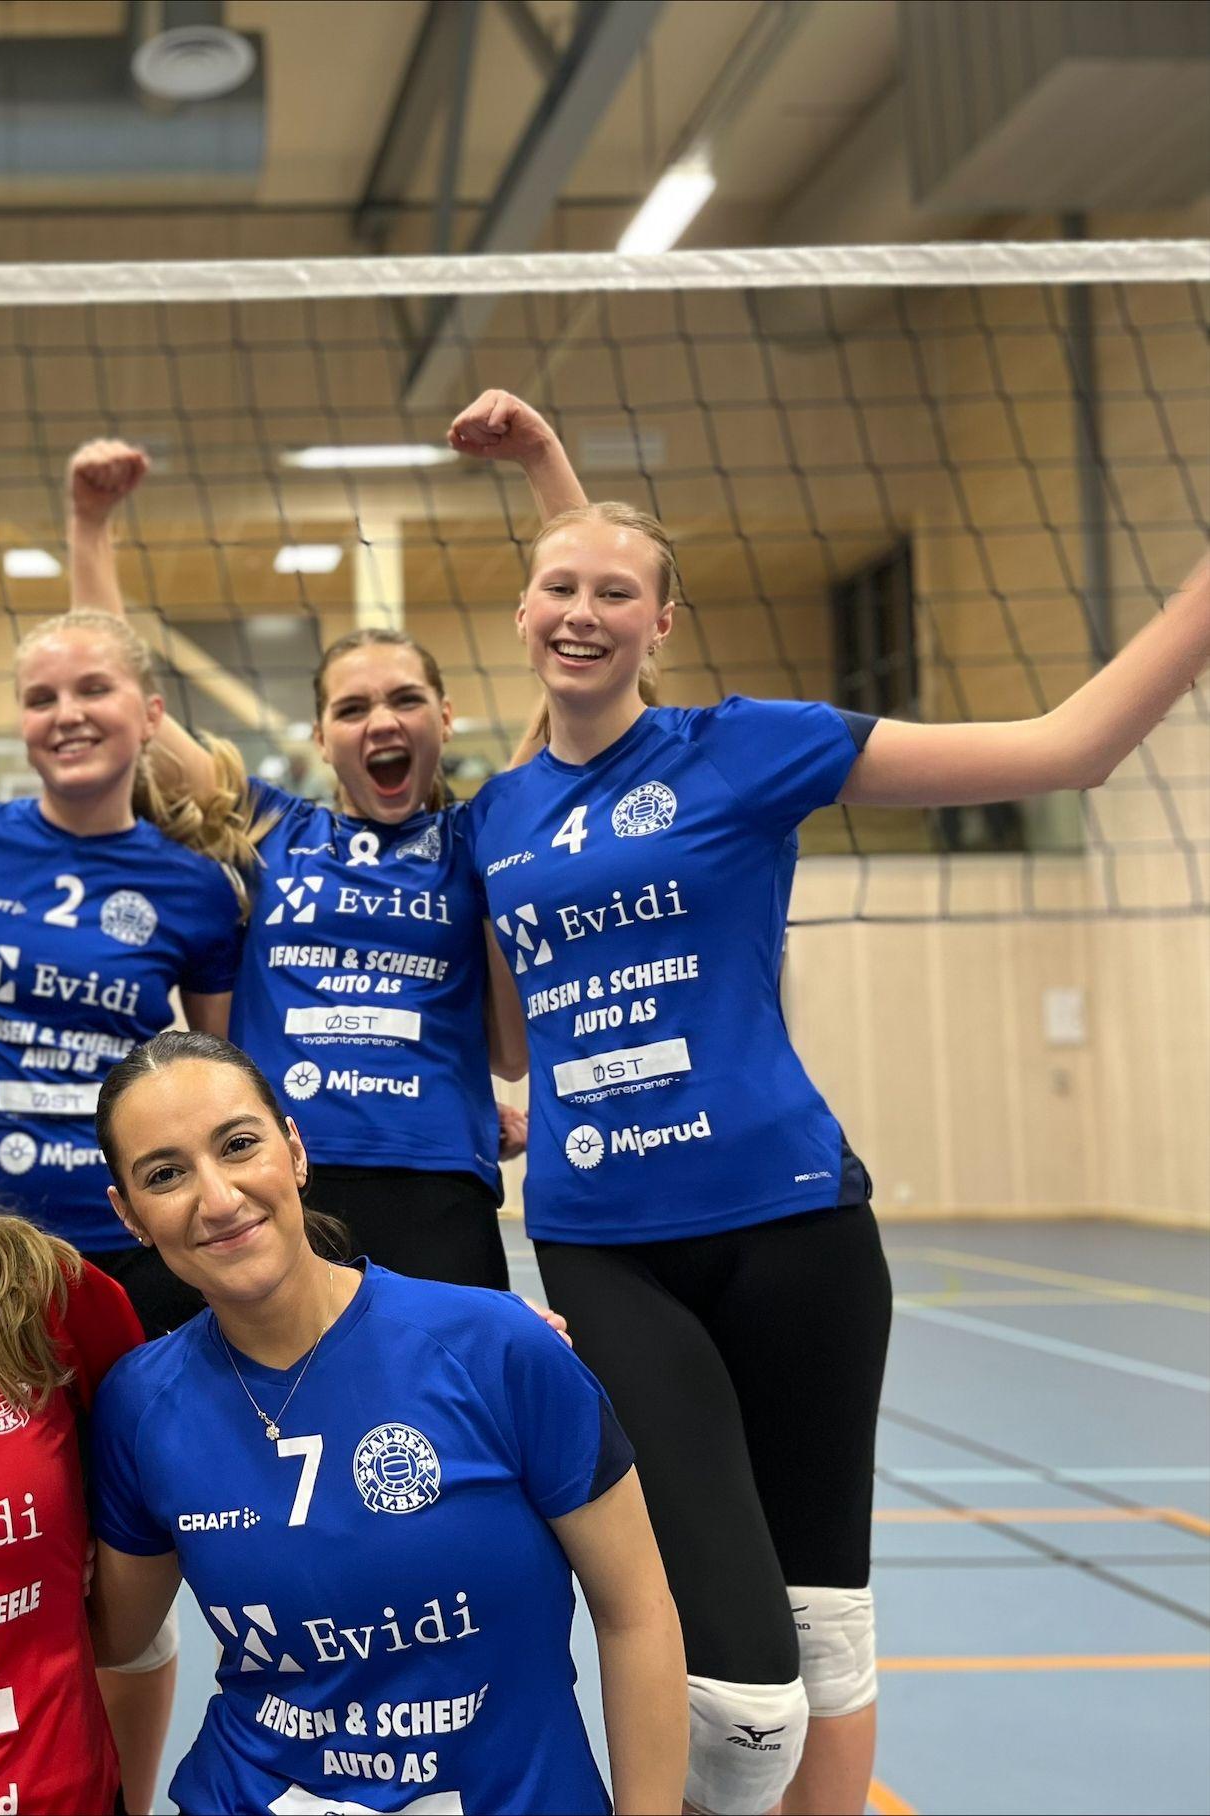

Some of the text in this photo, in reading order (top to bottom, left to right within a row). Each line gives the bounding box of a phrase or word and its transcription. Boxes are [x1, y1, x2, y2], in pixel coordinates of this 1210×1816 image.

[551, 805, 588, 854] 4
[345, 832, 380, 866] 8
[487, 853, 522, 876] CRAFT
[43, 874, 85, 928] 2
[335, 886, 452, 925] Evidi
[556, 880, 688, 942] Evidi
[268, 946, 449, 981] JENSEN & SCHEELE
[31, 964, 140, 1016] Evidi
[316, 975, 402, 994] AUTO AS
[527, 955, 699, 1020] JENSEN & SCHEELE
[325, 1014, 379, 1031] ØST
[573, 998, 656, 1038] AUTO AS
[38, 1027, 56, 1045] &
[20, 1047, 99, 1073] AUTO AS
[592, 1058, 644, 1084] ØST
[326, 1070, 419, 1098] Mjørud
[610, 1111, 712, 1156] Mjørud
[276, 1433, 323, 1527] 7
[178, 1510, 240, 1532] CRAFT
[301, 1591, 480, 1663] Evidi
[255, 1683, 489, 1740] JENSEN & SCHEELE
[725, 1735, 781, 1751] MIZUNO
[323, 1750, 437, 1783] AUTO AS
